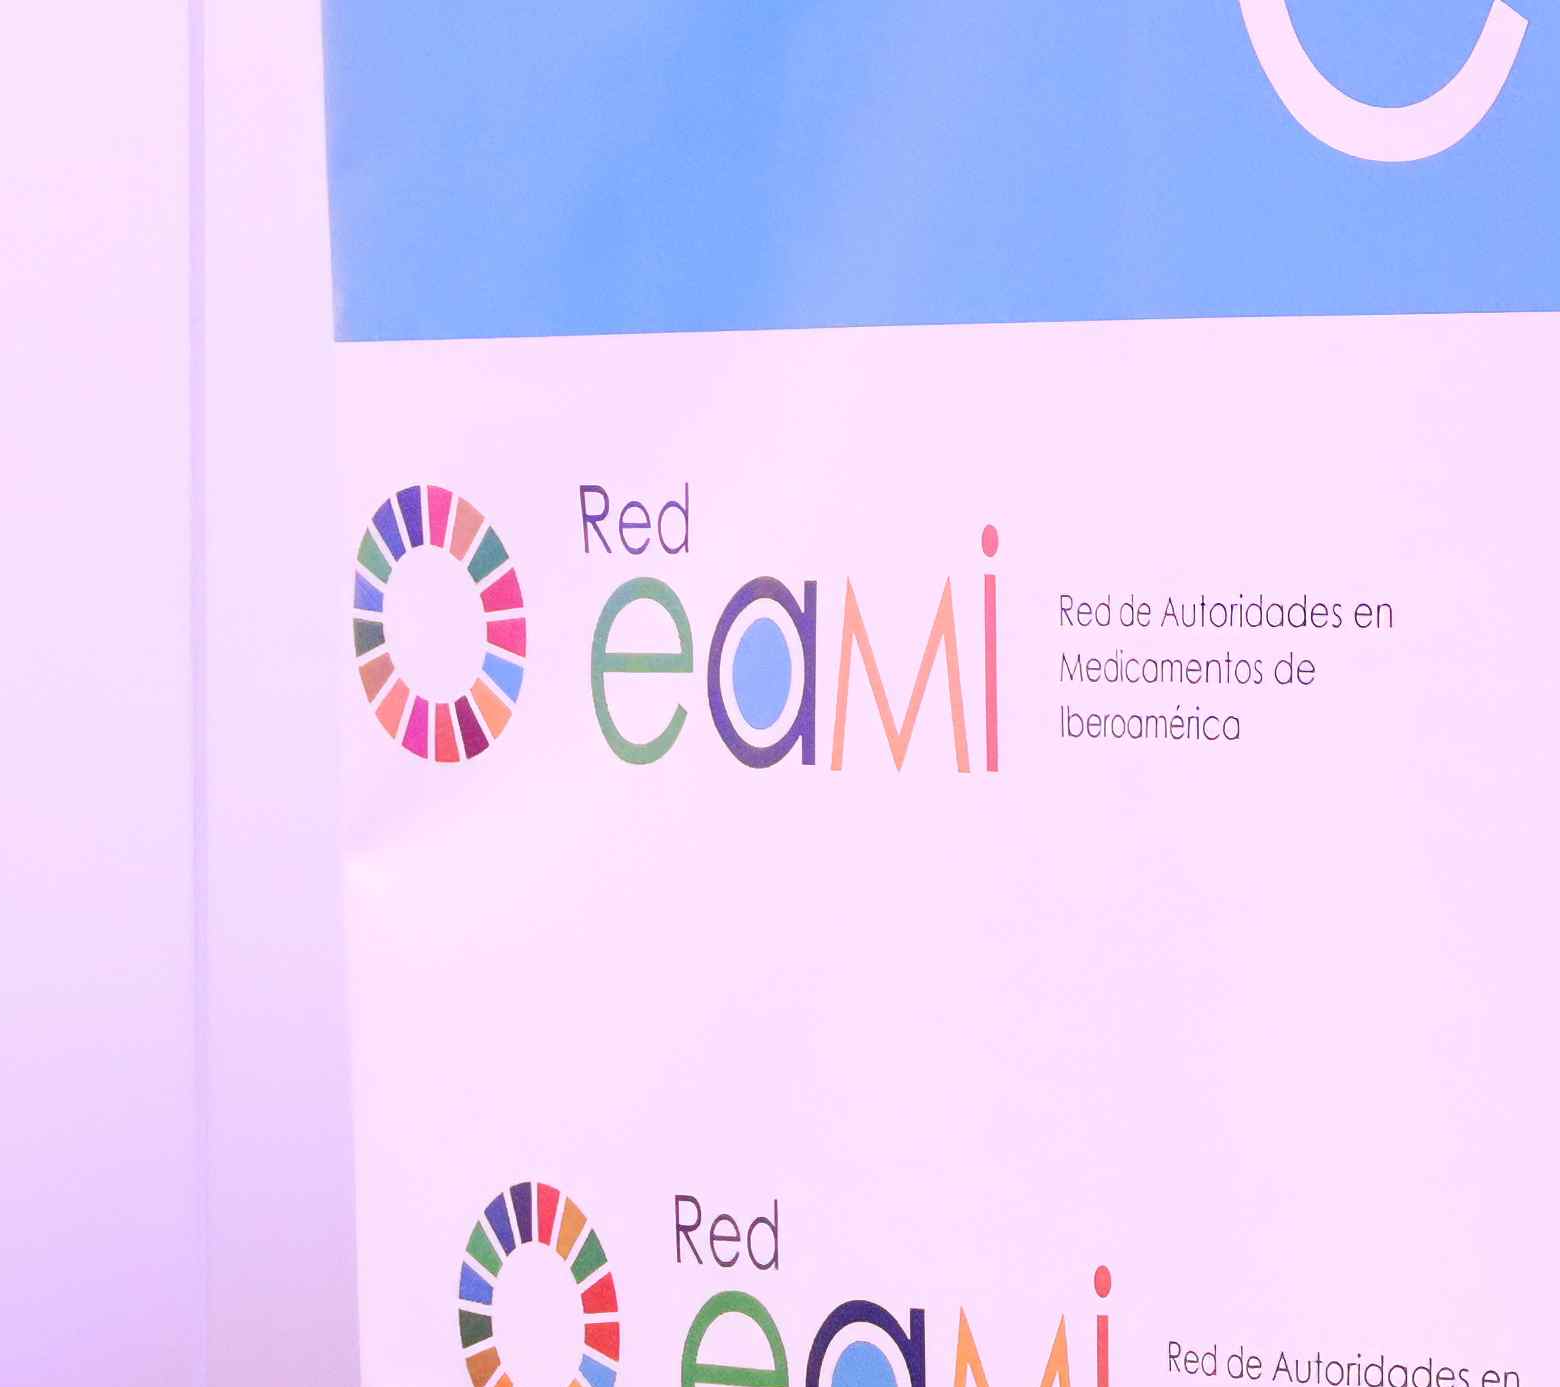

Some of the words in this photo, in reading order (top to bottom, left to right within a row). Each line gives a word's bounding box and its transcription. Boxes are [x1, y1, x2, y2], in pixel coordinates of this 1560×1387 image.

[580, 482, 689, 555] Red
[1060, 595, 1110, 626] Red
[1120, 594, 1151, 627] de
[1161, 594, 1342, 628] Autoridades
[1354, 603, 1392, 628] en
[1060, 649, 1262, 684] Medicamentos
[1275, 652, 1315, 685] de
[1061, 705, 1239, 740] Iberoamérica
[675, 1195, 778, 1270] Red
[1169, 1341, 1216, 1376] Red
[1227, 1346, 1262, 1380] de
